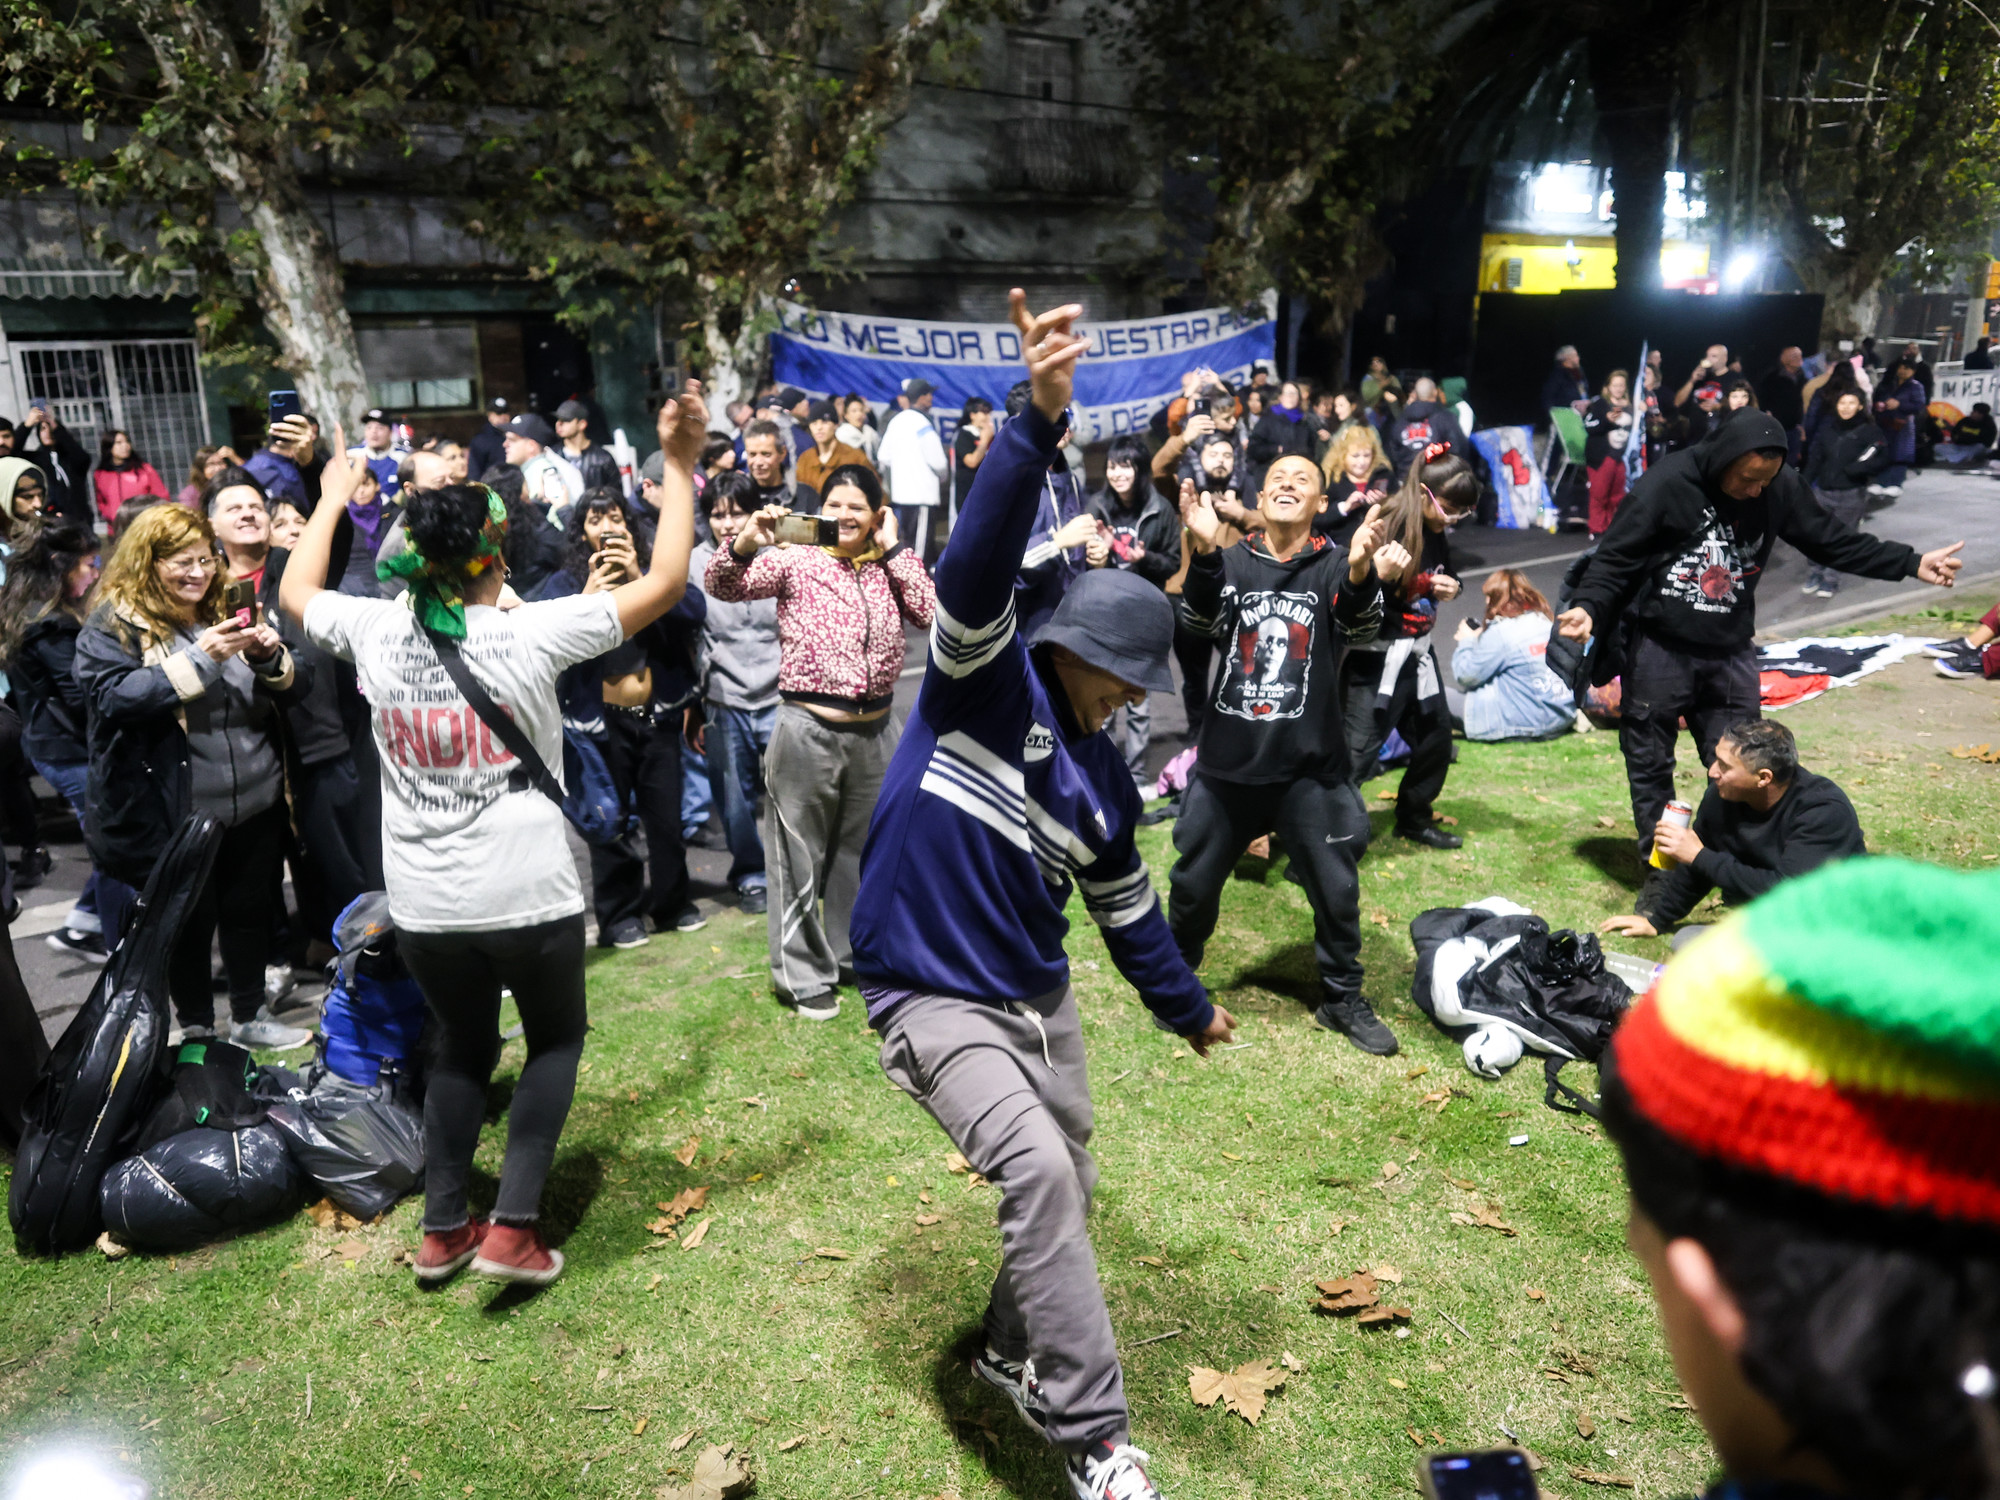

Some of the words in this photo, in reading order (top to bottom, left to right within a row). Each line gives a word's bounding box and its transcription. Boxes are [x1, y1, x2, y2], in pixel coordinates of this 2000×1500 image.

[841, 320, 984, 360] MEJOR
[996, 331, 1021, 361] D
[1077, 318, 1211, 358] UESTRA
[1270, 596, 1315, 628] SOLARI
[389, 688, 405, 703] NO
[380, 704, 516, 769] INDIO
